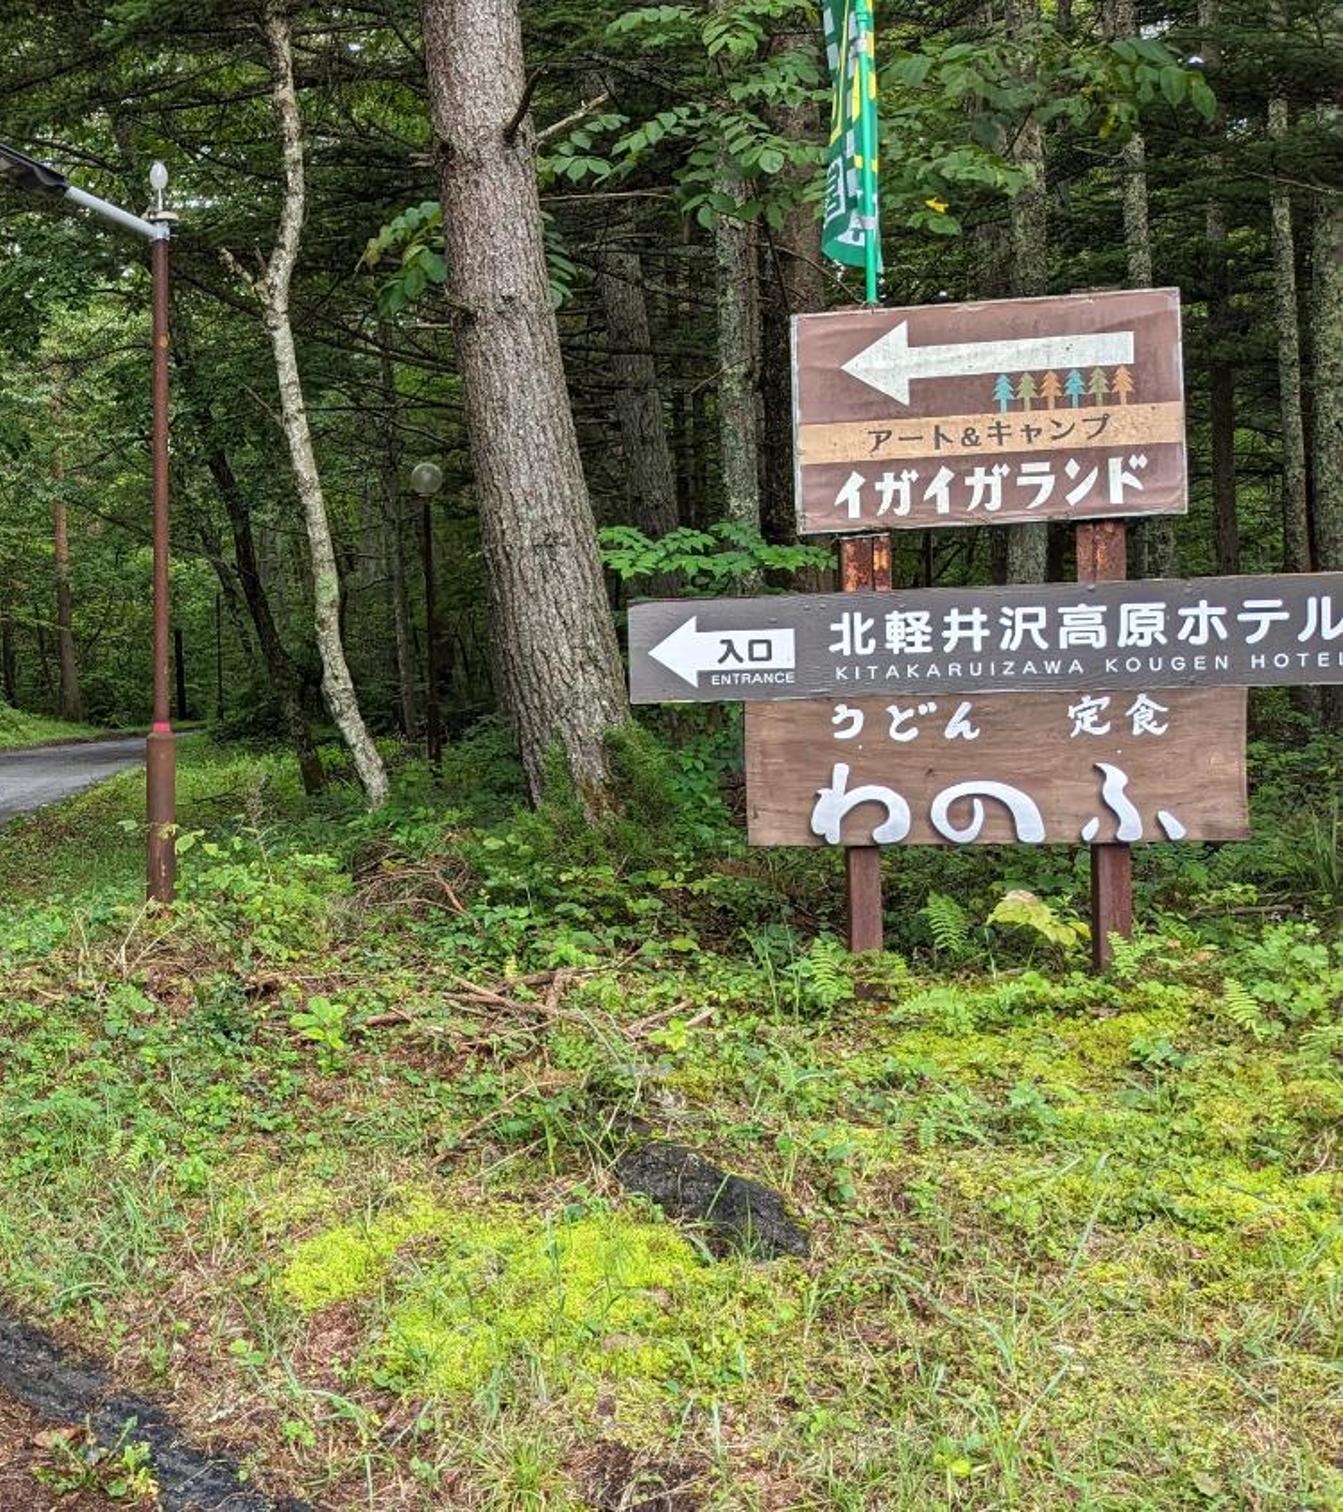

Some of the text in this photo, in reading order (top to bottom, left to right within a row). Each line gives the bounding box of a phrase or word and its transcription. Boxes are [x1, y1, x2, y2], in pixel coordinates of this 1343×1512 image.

[868, 413, 1110, 453] アート&キャンプ
[834, 453, 1147, 519] イガイガランド
[828, 596, 1343, 656] 北軽井沢高原ホテル
[718, 639, 772, 664] 入口
[836, 659, 1085, 680] KITAKARUIZAWA
[1105, 655, 1229, 672] KOUGEN
[711, 671, 796, 686] ENTRANCE
[831, 693, 1169, 742] うどん 定食
[810, 762, 1187, 845] わのふ
